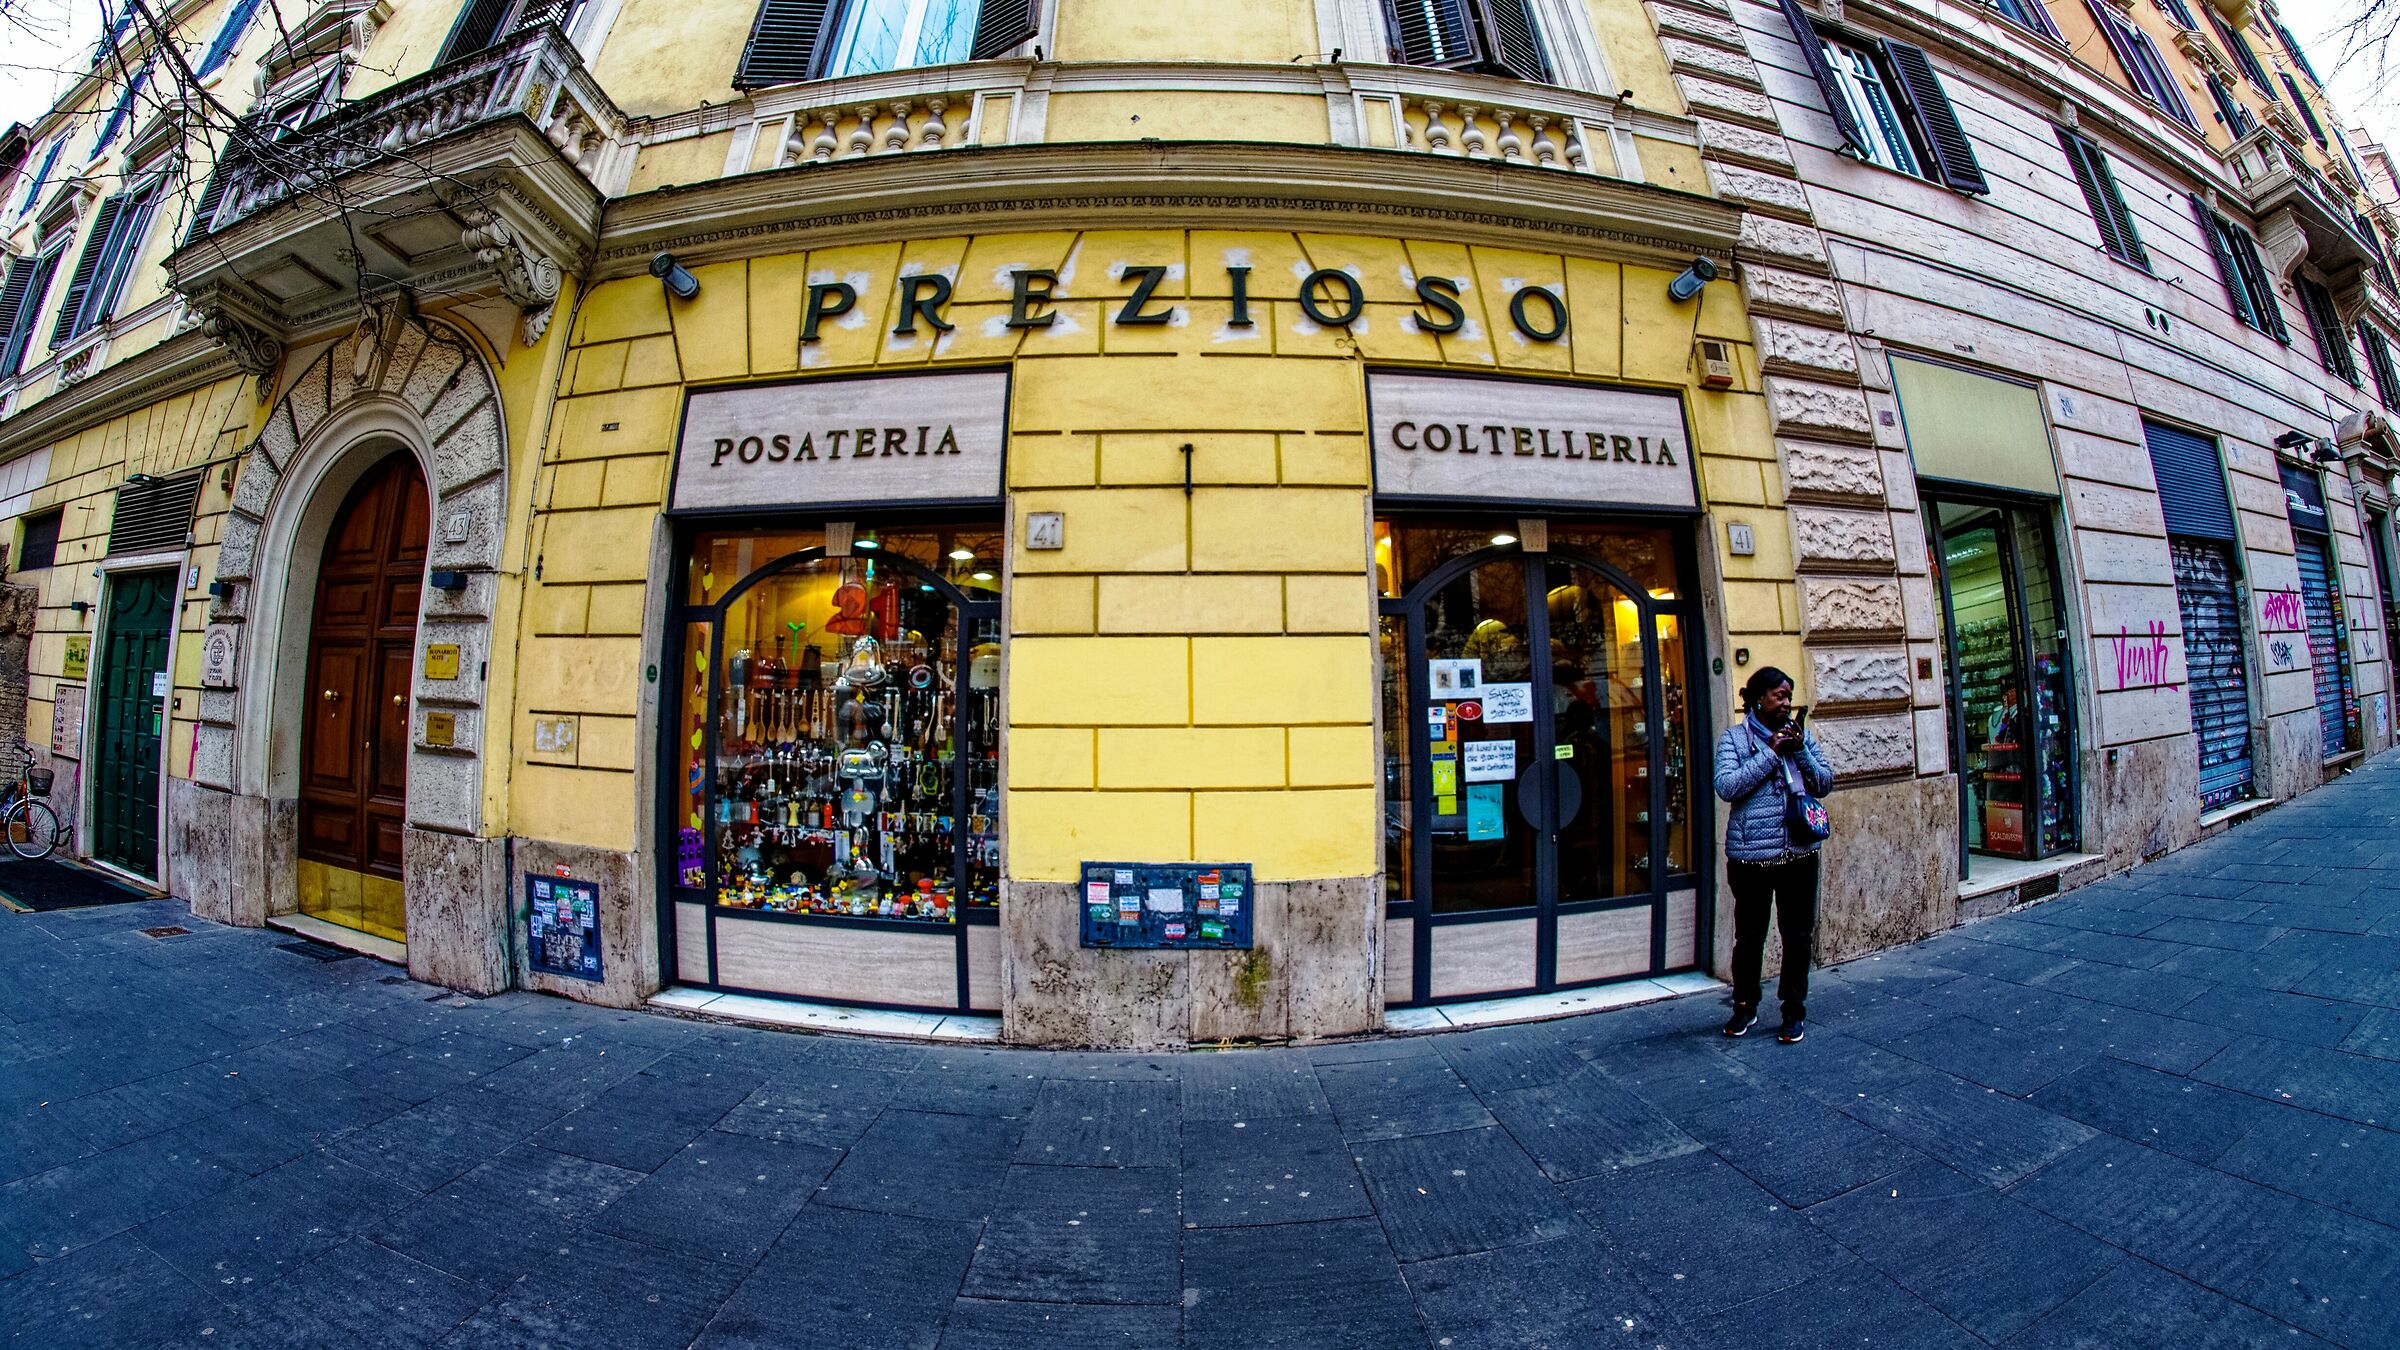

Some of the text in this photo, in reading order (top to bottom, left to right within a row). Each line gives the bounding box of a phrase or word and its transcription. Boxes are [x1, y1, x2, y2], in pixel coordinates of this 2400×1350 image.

[799, 265, 1568, 342] PREZIOSO
[710, 423, 962, 467] POSATERIA
[1391, 420, 1678, 467] COLTELLERIA
[448, 517, 464, 536] 43
[1735, 530, 1750, 549] 41
[1488, 688, 1525, 700] SABATO
